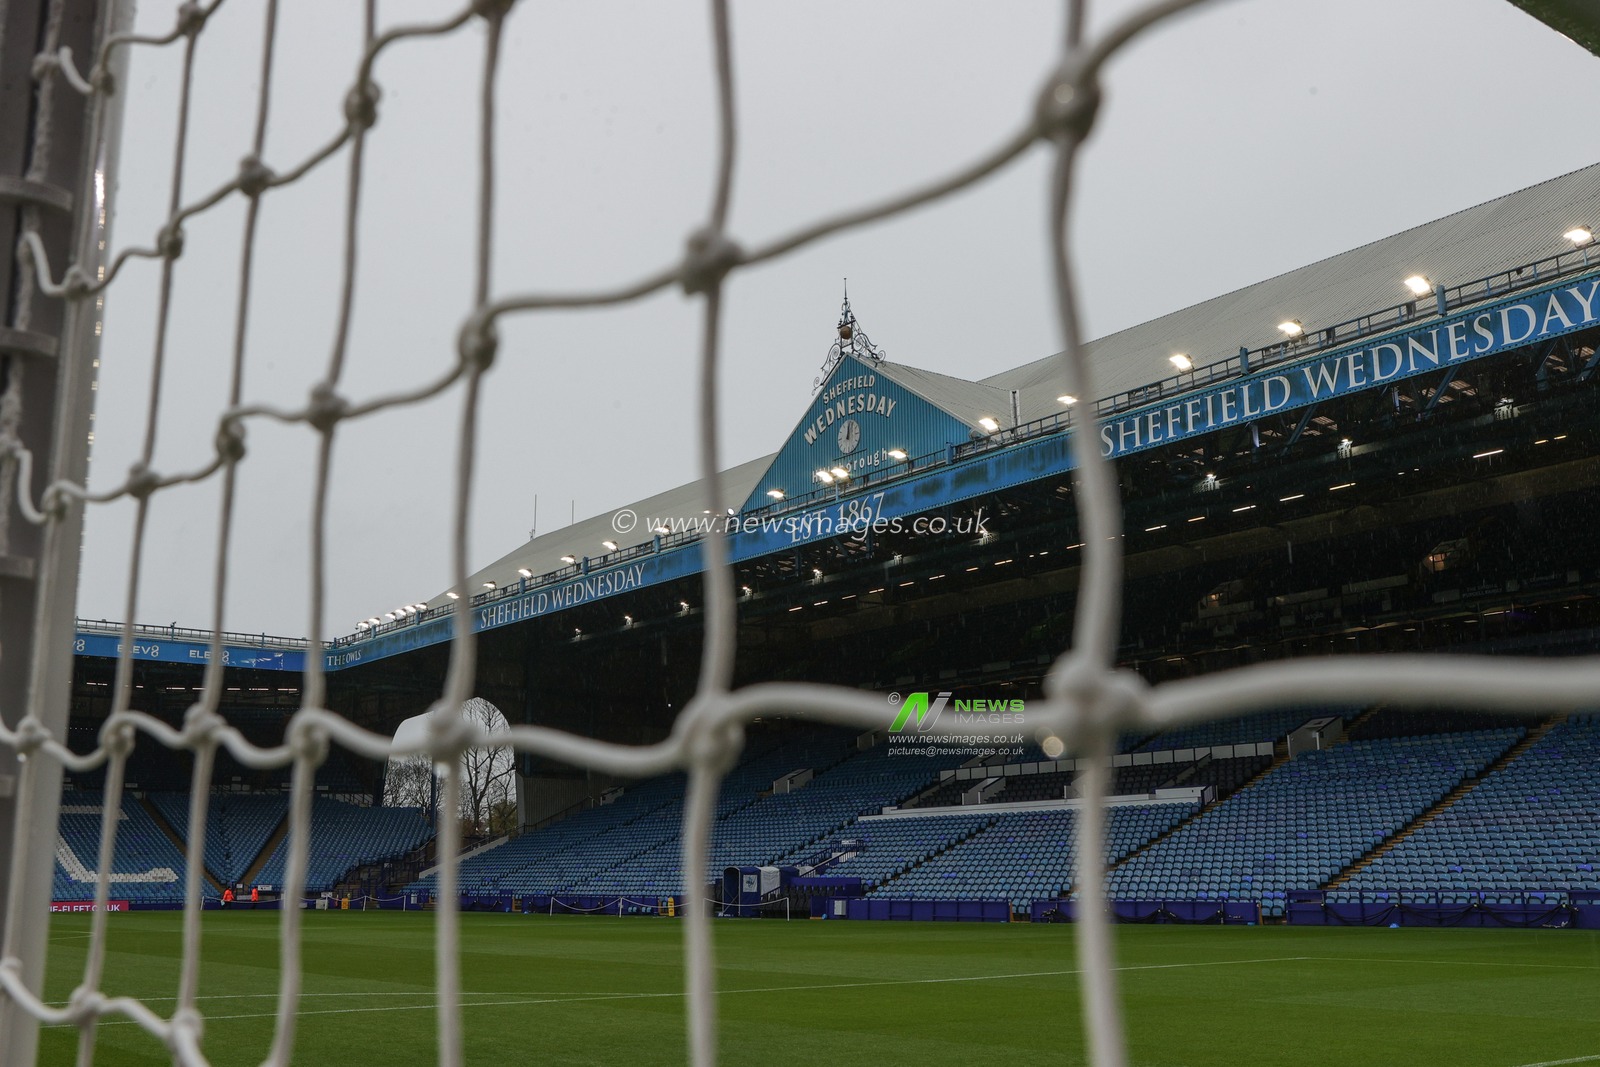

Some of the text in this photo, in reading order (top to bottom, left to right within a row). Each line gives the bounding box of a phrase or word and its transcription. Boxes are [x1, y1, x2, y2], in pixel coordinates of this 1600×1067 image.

[1101, 280, 1600, 457] SHEFFIELD WEDNESDAY
[823, 374, 876, 405] SHEFFIELD
[803, 393, 897, 446] WEDNESDAY
[837, 492, 885, 532] 1867
[480, 563, 647, 629] SHEFFIELD WEDNESDAY
[117, 644, 160, 658] EEV8
[189, 649, 230, 663] ELE8
[327, 650, 362, 666] THE OWLS
